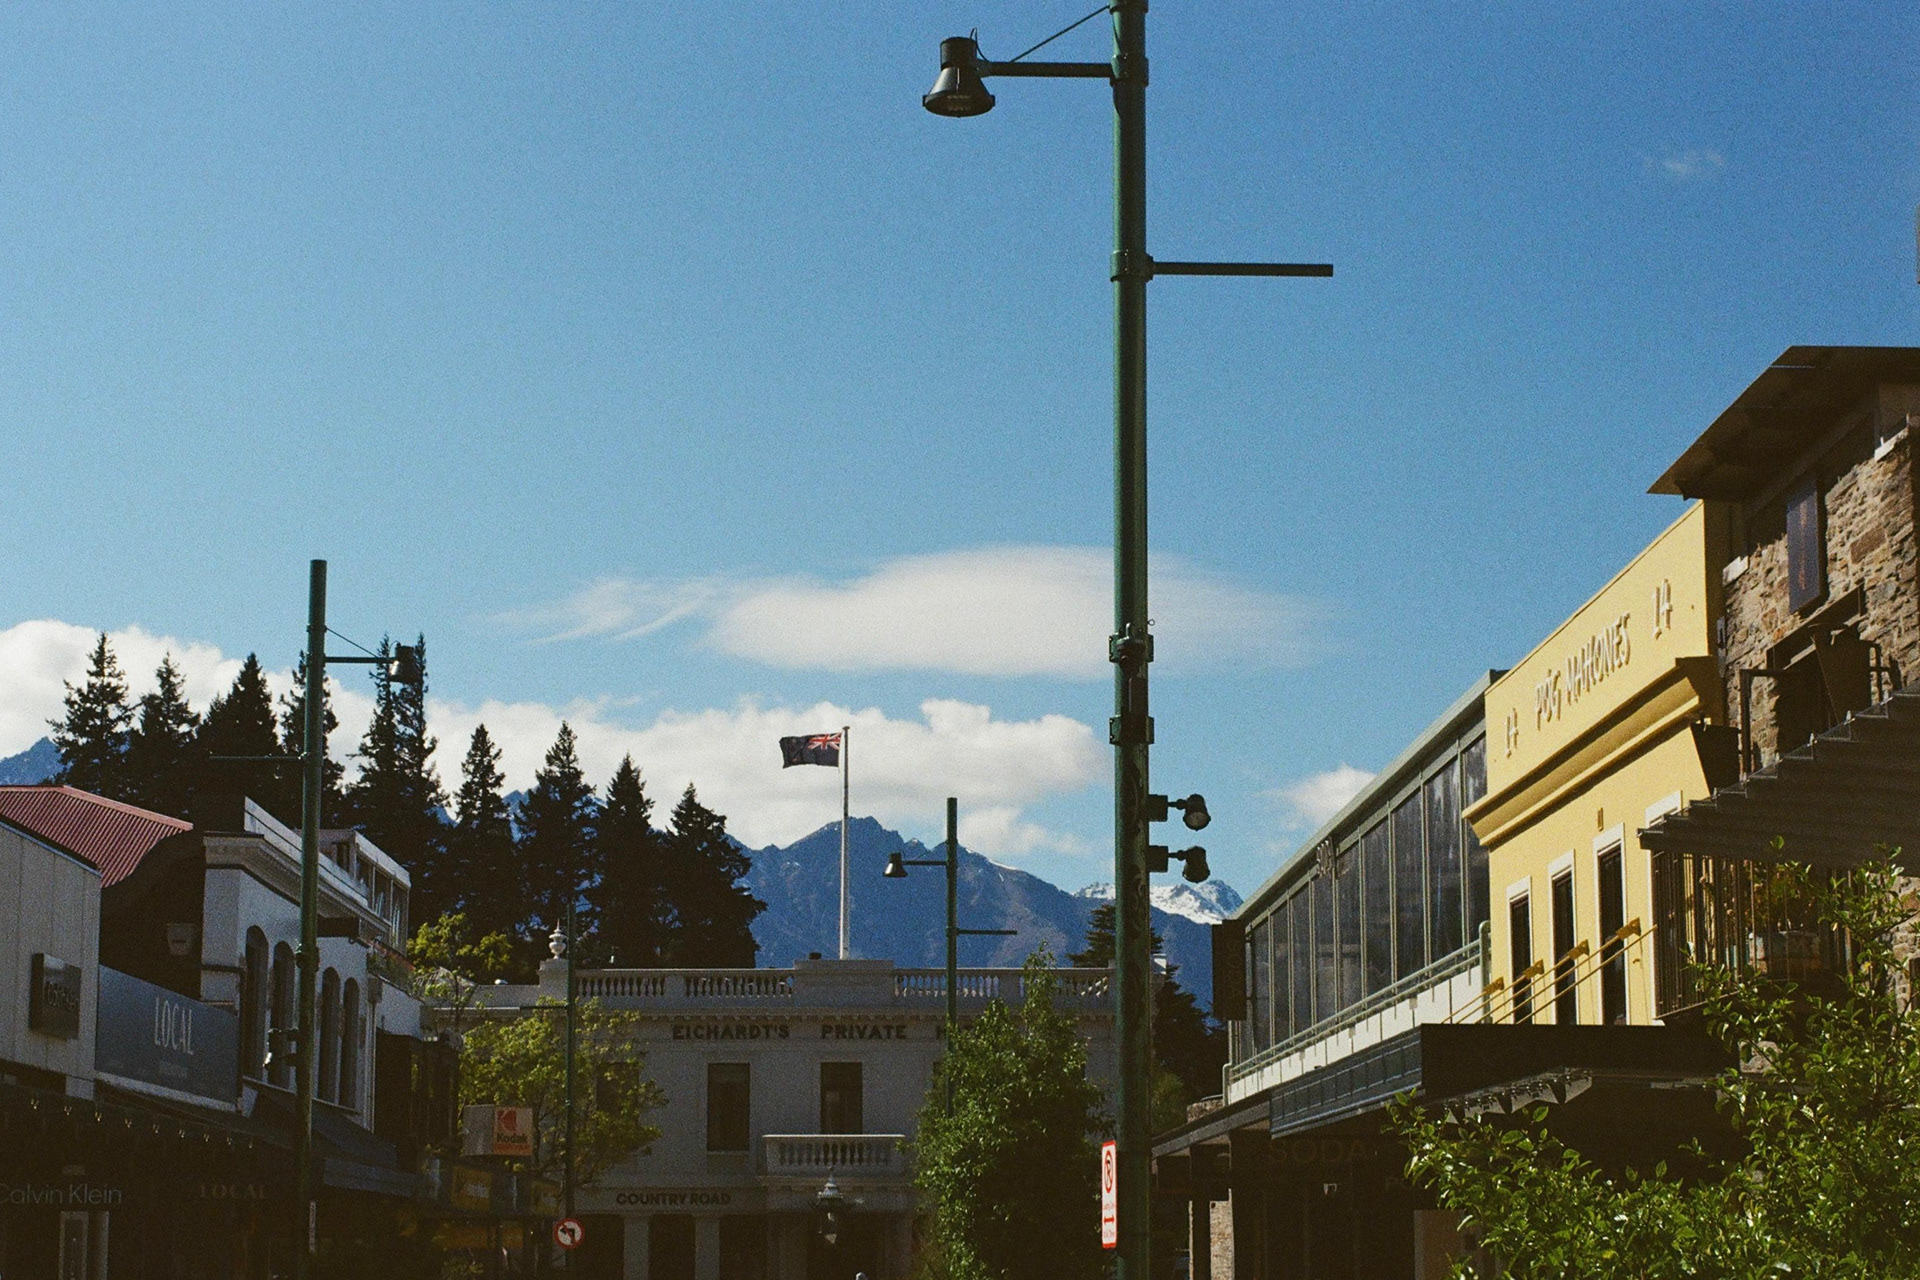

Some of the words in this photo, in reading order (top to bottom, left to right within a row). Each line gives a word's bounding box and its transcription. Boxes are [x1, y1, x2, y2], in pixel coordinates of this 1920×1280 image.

[1564, 612, 1632, 704] MAHONES
[153, 996, 195, 1056] LOCAL
[672, 1024, 791, 1040] EICHARDT'S
[821, 1024, 906, 1040] PRIVATE
[496, 1132, 529, 1144] Kodak
[1266, 1138, 1368, 1165] SODA
[68, 1182, 123, 1205] Klein
[199, 1183, 266, 1200] LOCAL
[615, 1192, 687, 1207] COUNTRY
[690, 1192, 732, 1207] ROAD
